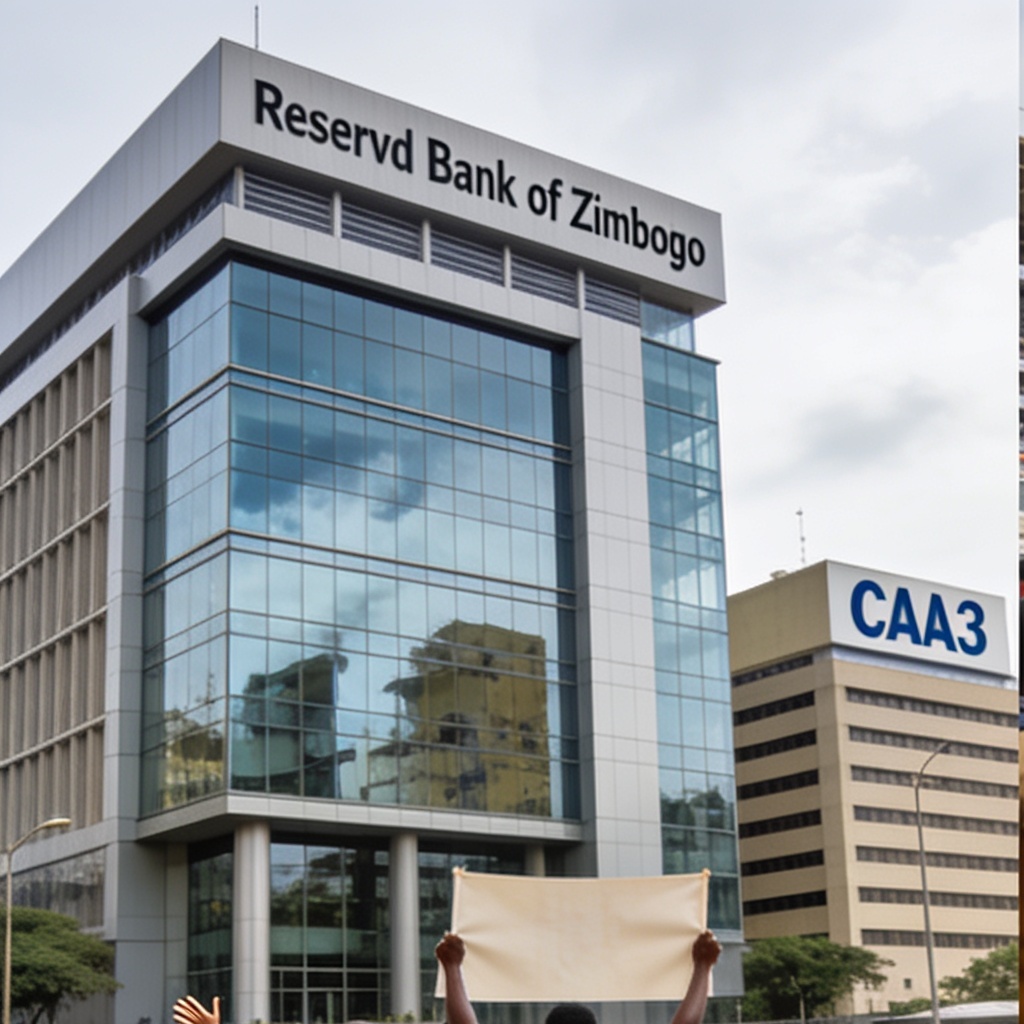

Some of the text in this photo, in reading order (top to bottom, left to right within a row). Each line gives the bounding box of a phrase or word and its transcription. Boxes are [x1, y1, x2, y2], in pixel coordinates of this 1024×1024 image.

[254, 79, 705, 271] Reservd Bank of Zimbogo
[850, 579, 987, 656] CAA3
